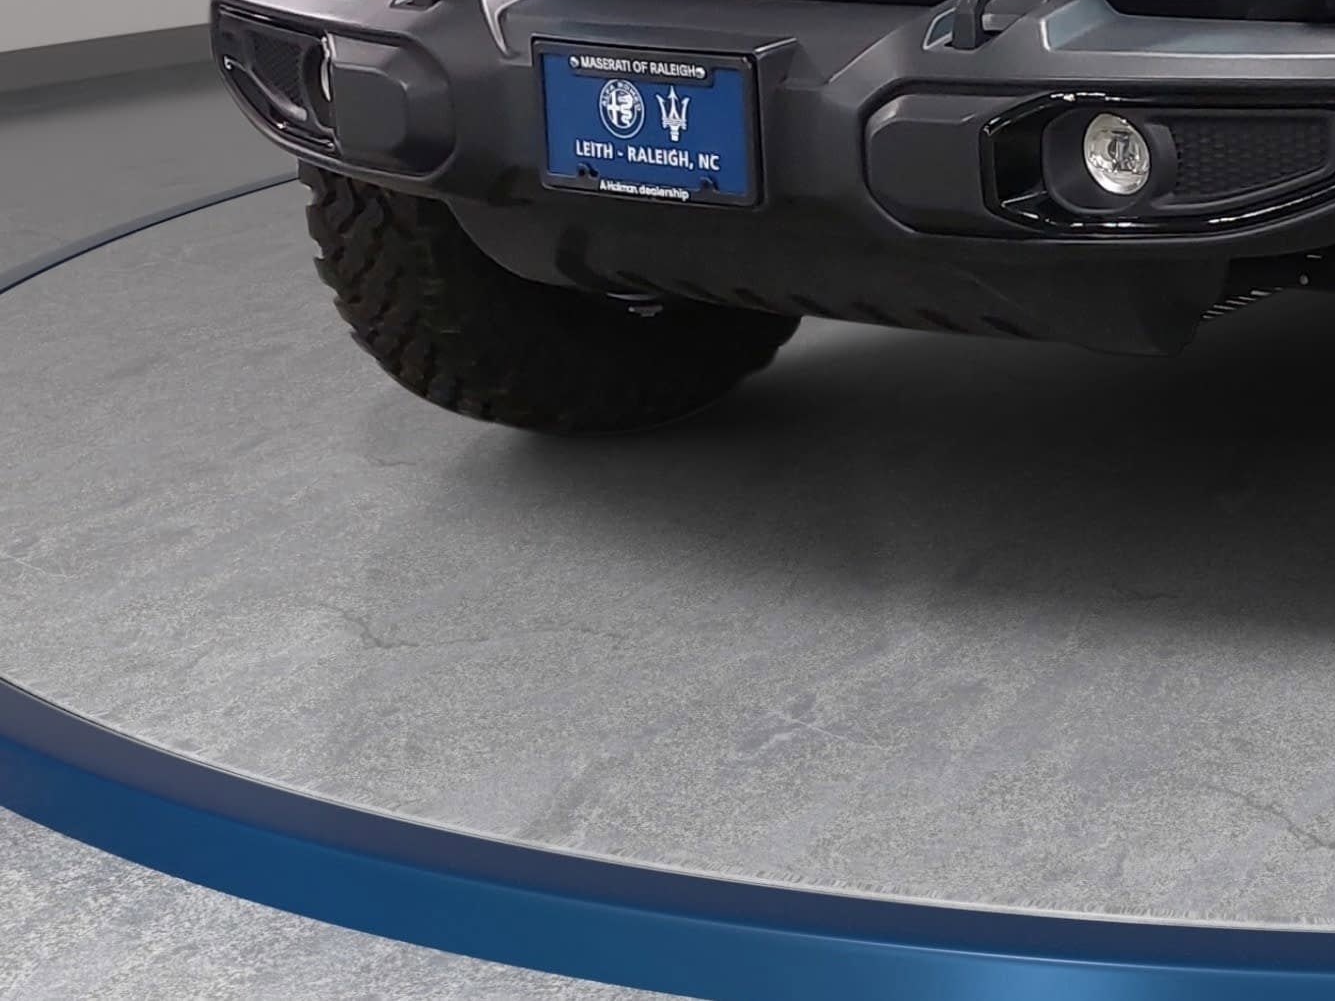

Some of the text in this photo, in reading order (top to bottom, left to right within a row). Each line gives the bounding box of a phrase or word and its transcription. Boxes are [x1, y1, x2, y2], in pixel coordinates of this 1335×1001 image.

[580, 56, 696, 78] MASERATI OF RALEIGH
[576, 139, 613, 159] LEITH
[627, 145, 694, 170] RALEIGH,
[698, 153, 720, 170] NC
[599, 179, 607, 190] A
[638, 185, 690, 202] dealership
